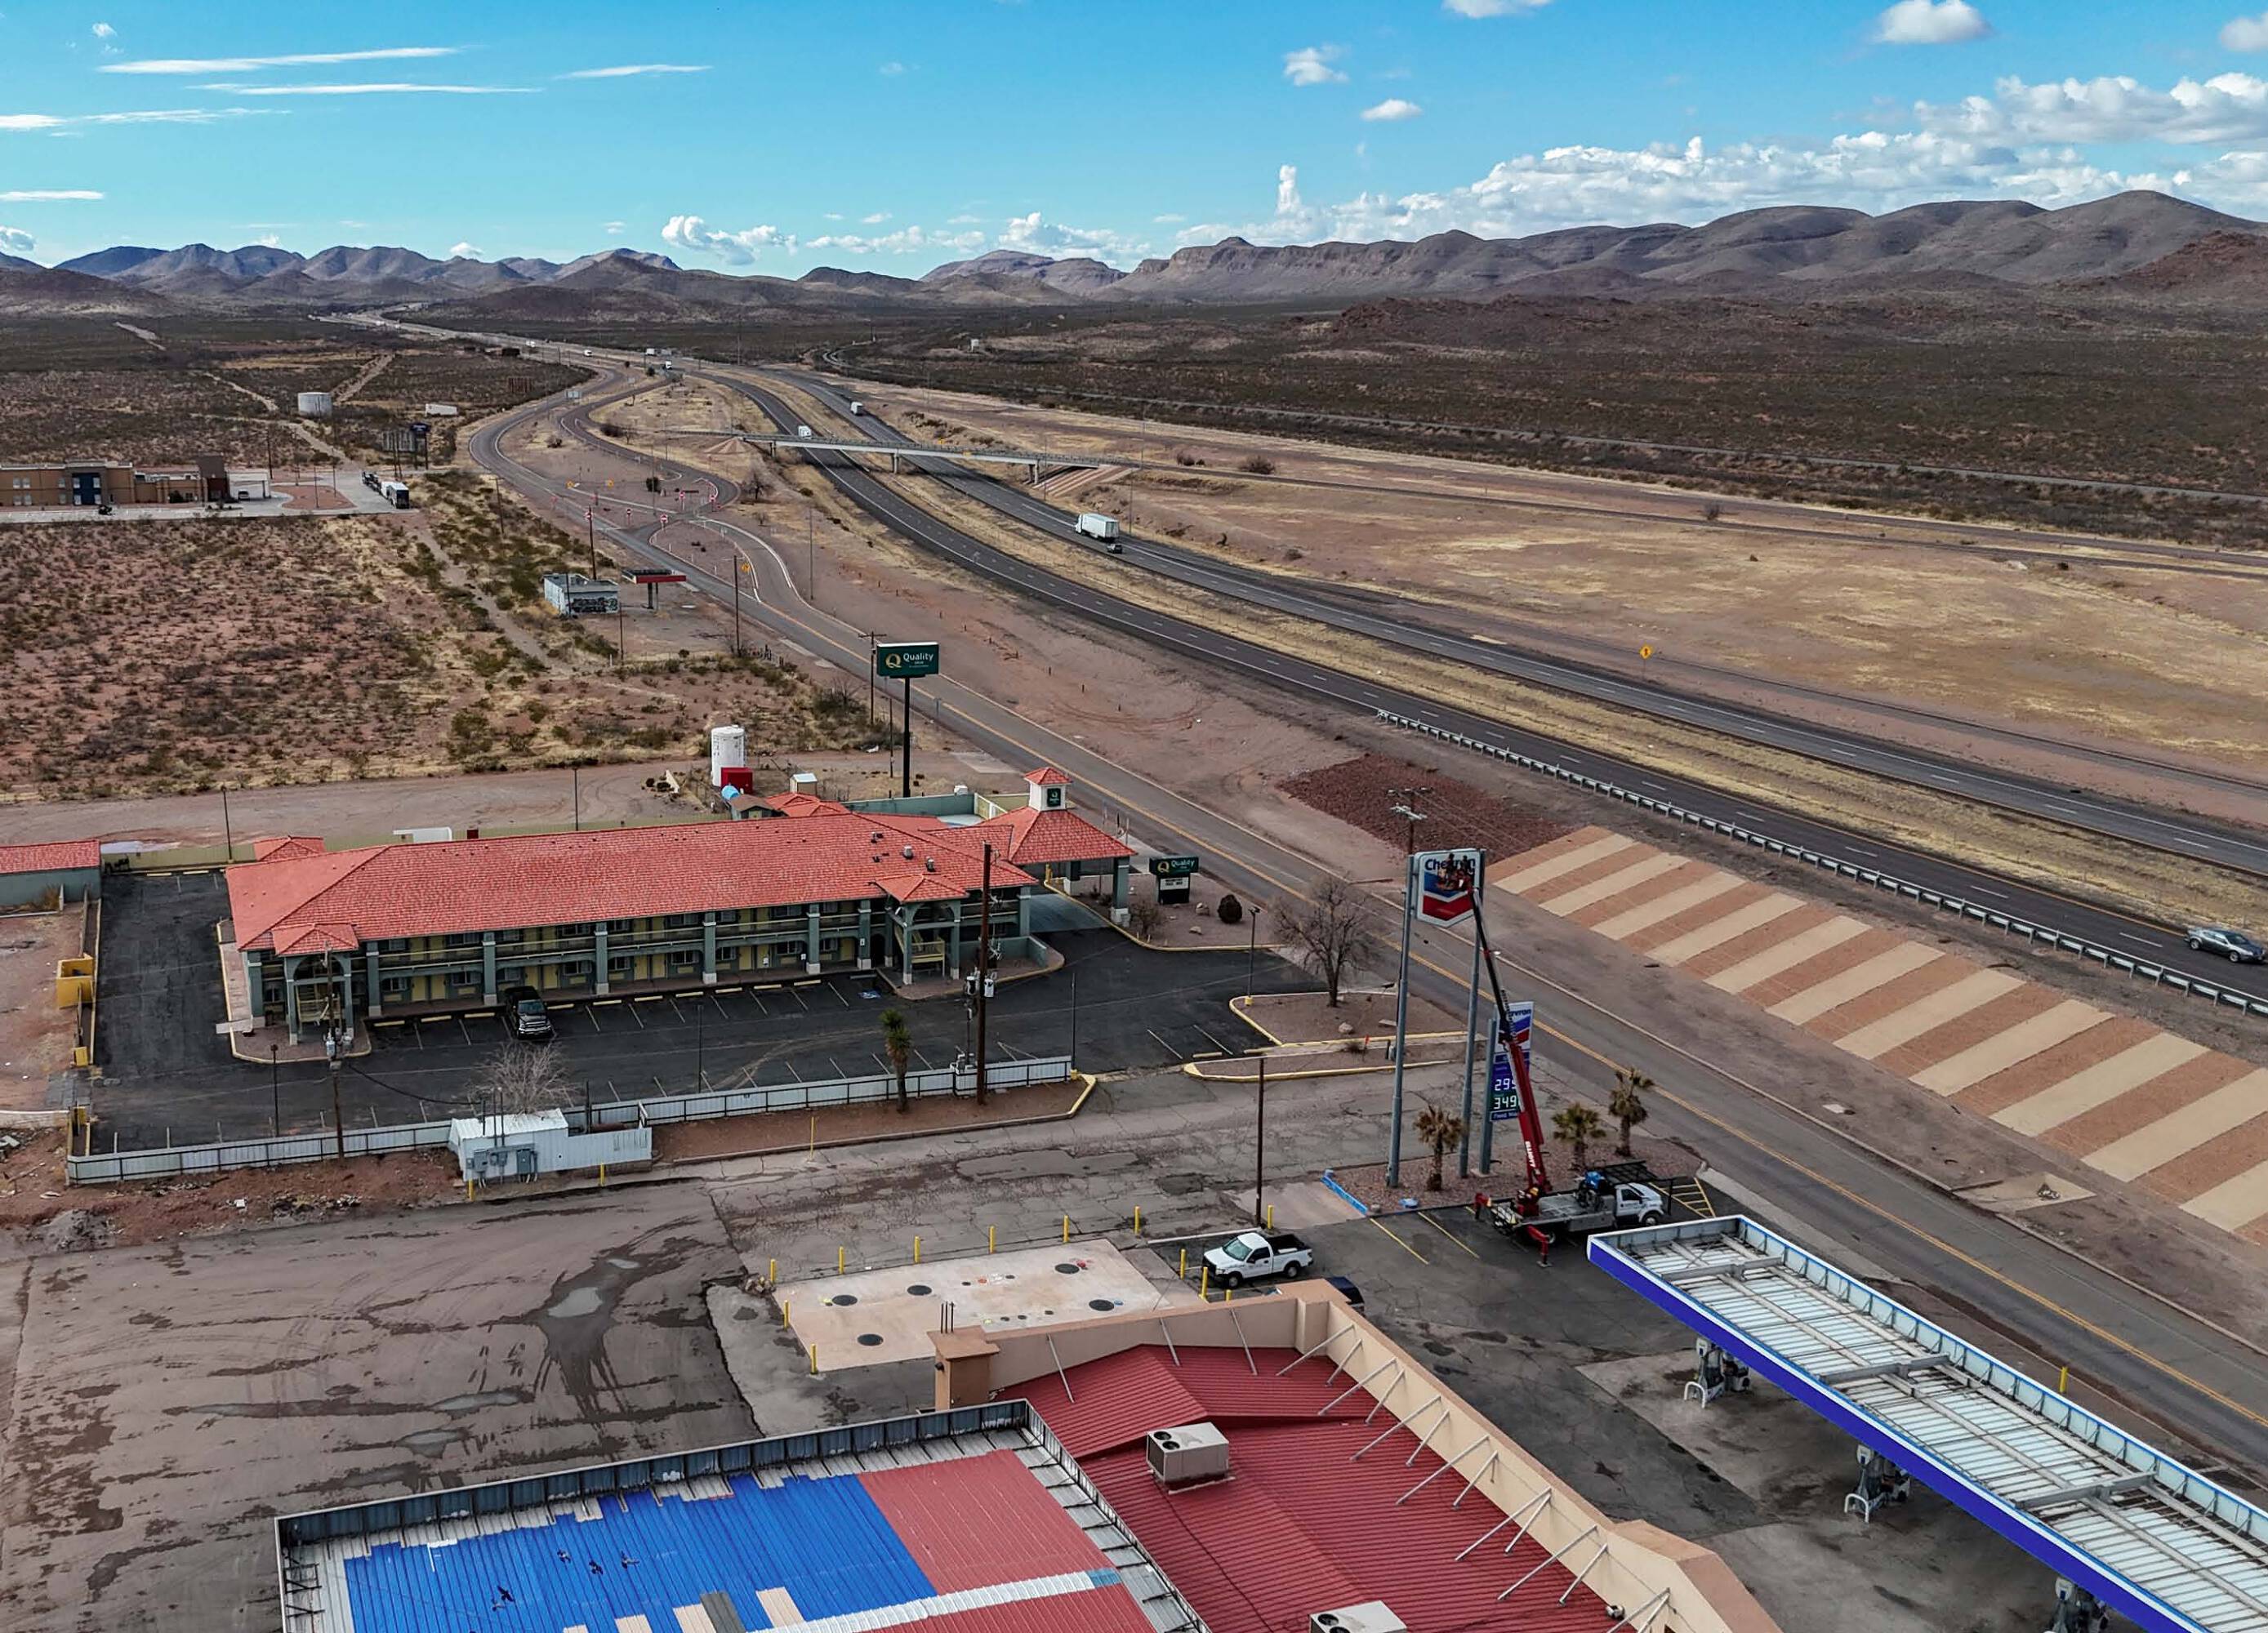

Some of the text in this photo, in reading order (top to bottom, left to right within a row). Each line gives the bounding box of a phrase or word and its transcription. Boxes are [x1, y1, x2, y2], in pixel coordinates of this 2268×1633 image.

[903, 652, 933, 662] Quality
[1170, 860, 1196, 868] Quality
[1425, 858, 1476, 870] Chern
[1493, 1095, 1517, 1109] 349
